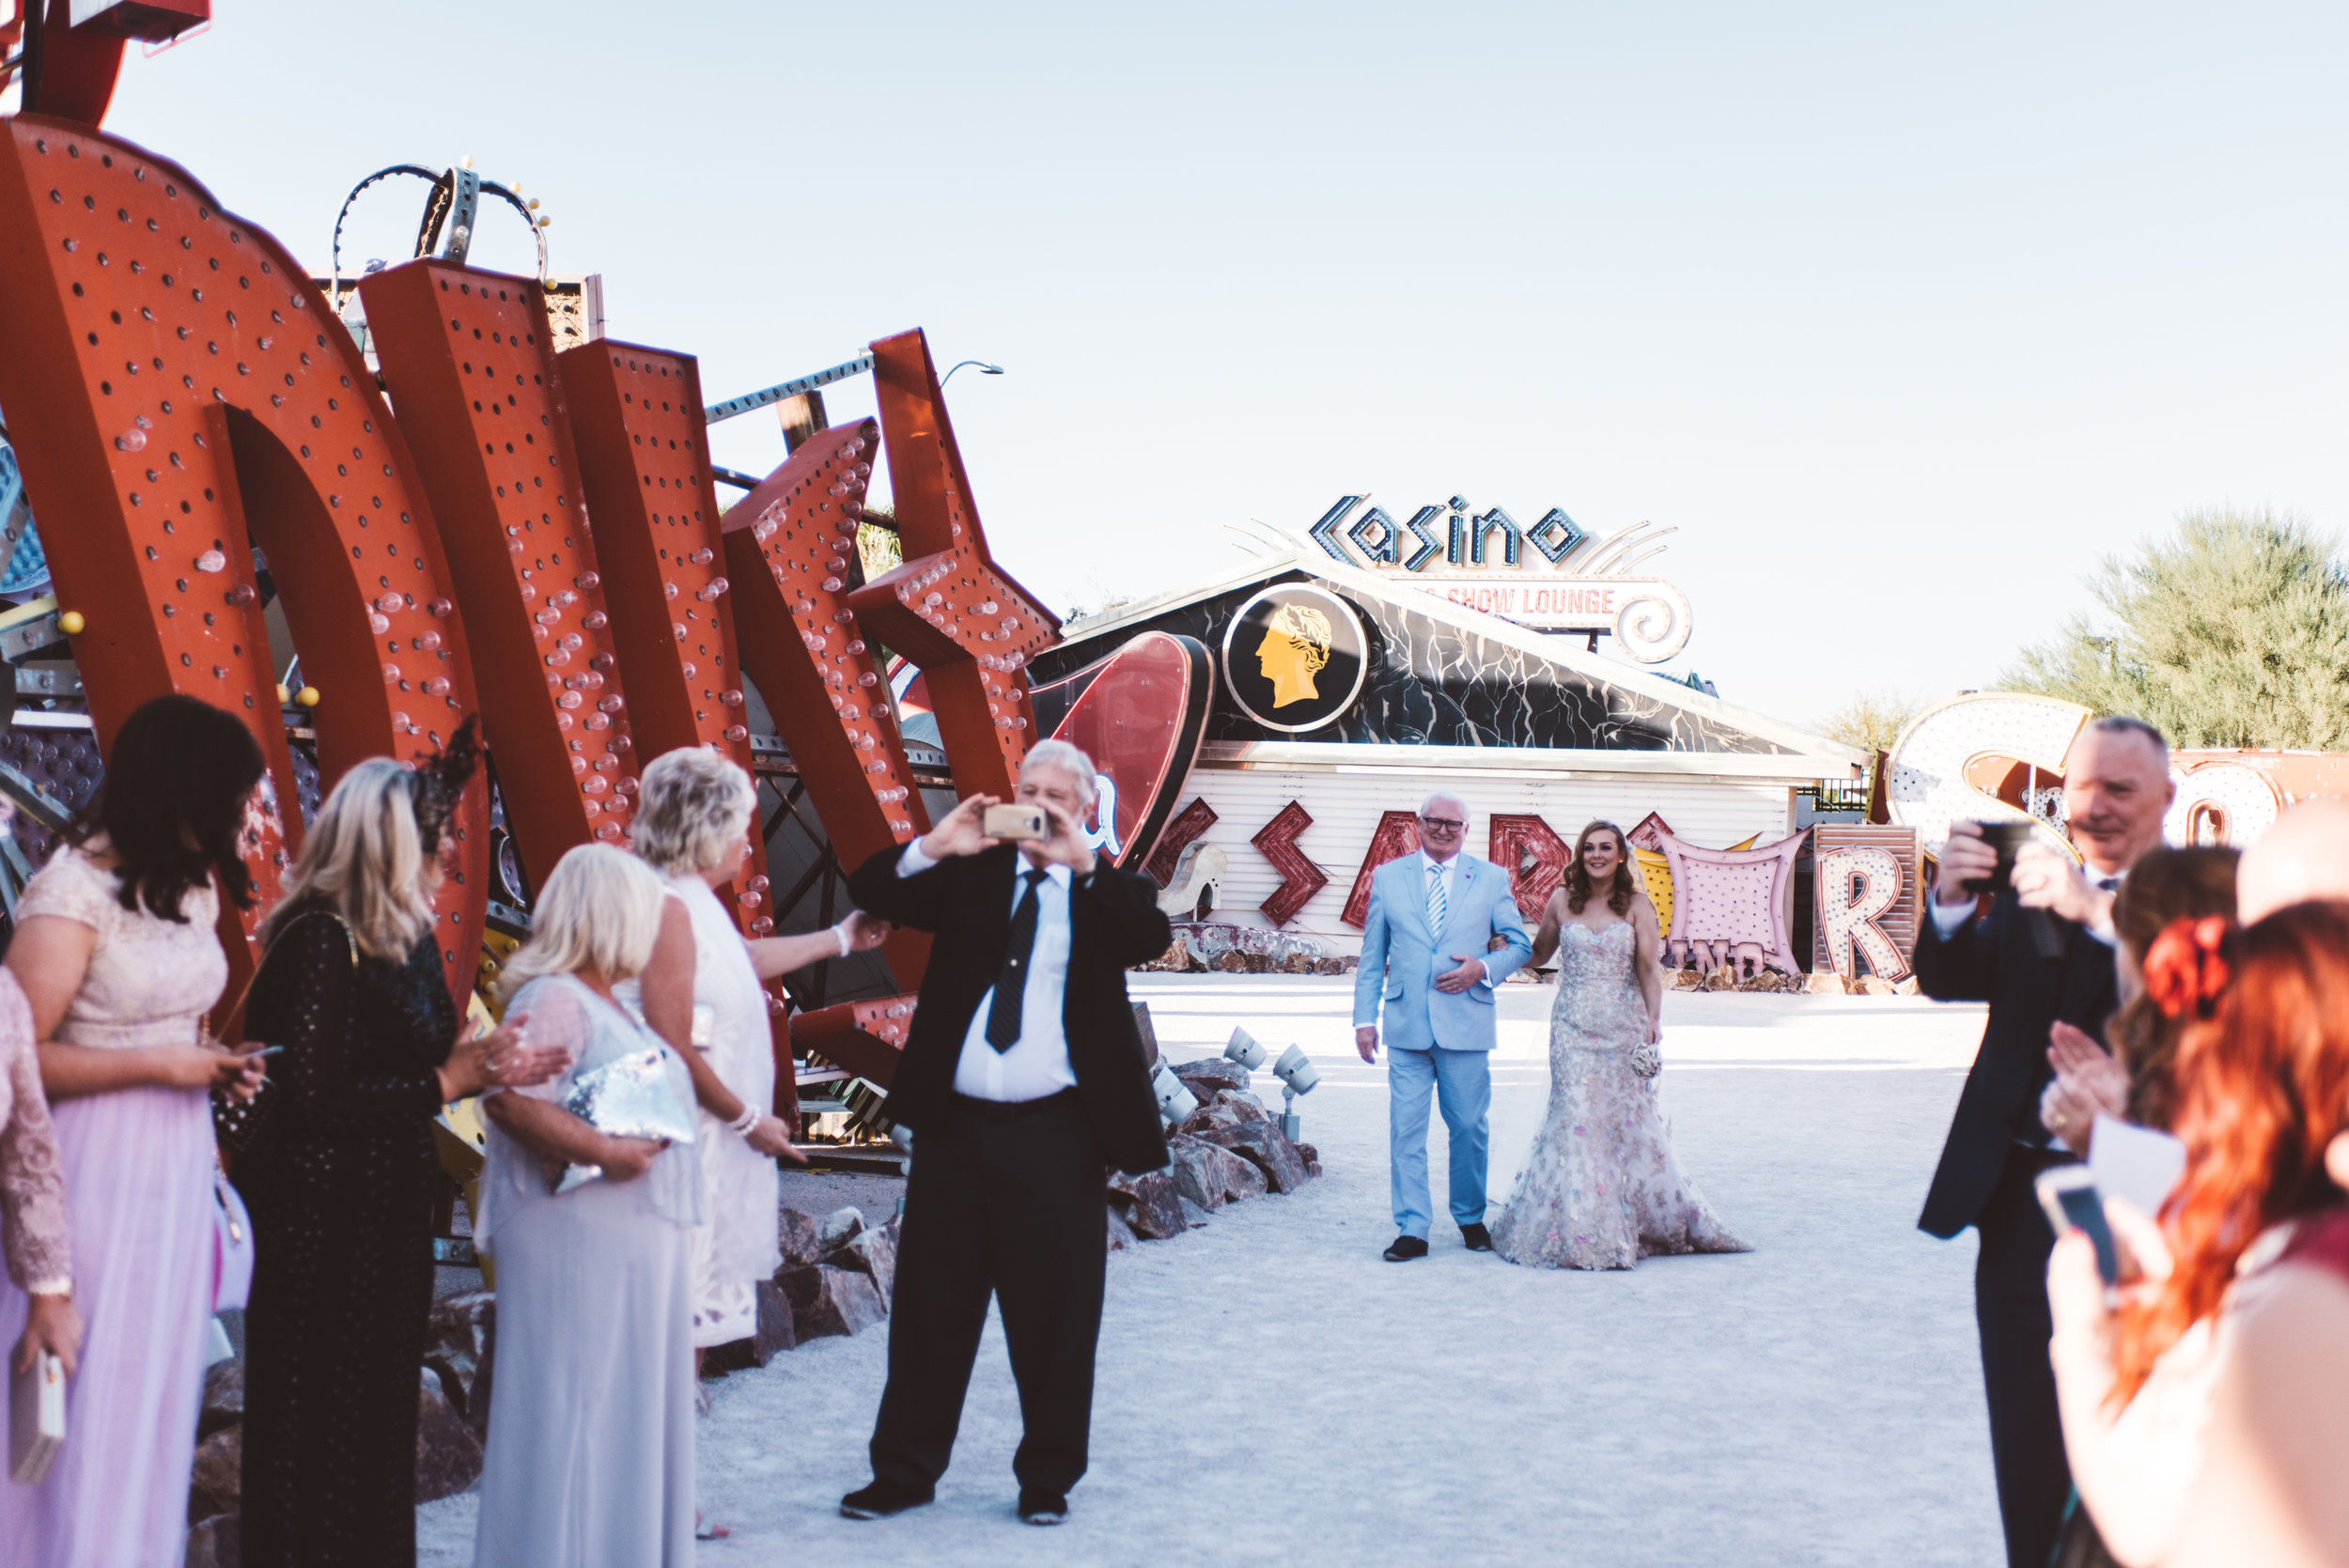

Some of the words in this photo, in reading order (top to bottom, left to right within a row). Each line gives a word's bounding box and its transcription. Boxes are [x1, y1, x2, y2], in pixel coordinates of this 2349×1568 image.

[1308, 491, 1588, 572] Casino
[1523, 589, 1614, 614] LOUNGE
[1816, 846, 1913, 985] R
